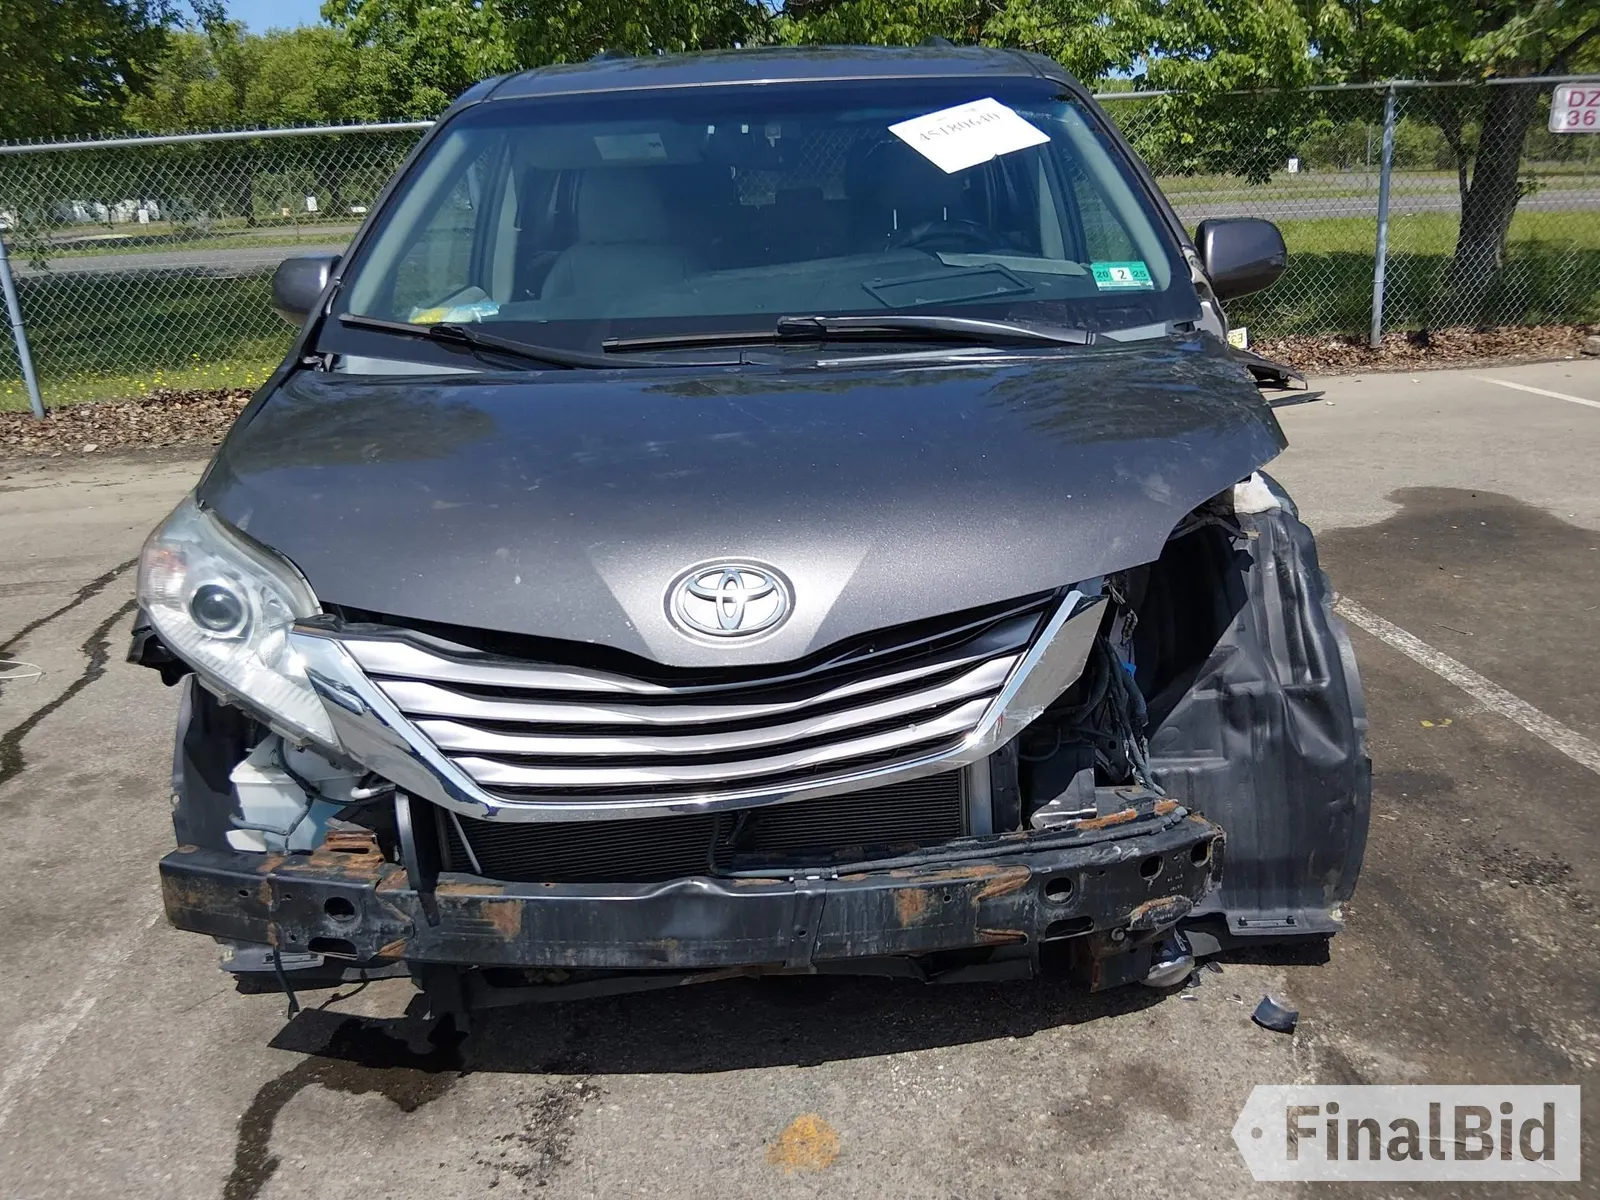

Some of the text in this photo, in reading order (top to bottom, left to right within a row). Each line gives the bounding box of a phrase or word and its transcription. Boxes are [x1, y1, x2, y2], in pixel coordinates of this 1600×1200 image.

[1567, 110, 1597, 126] 36
[1096, 269, 1146, 280] 20 2 25
